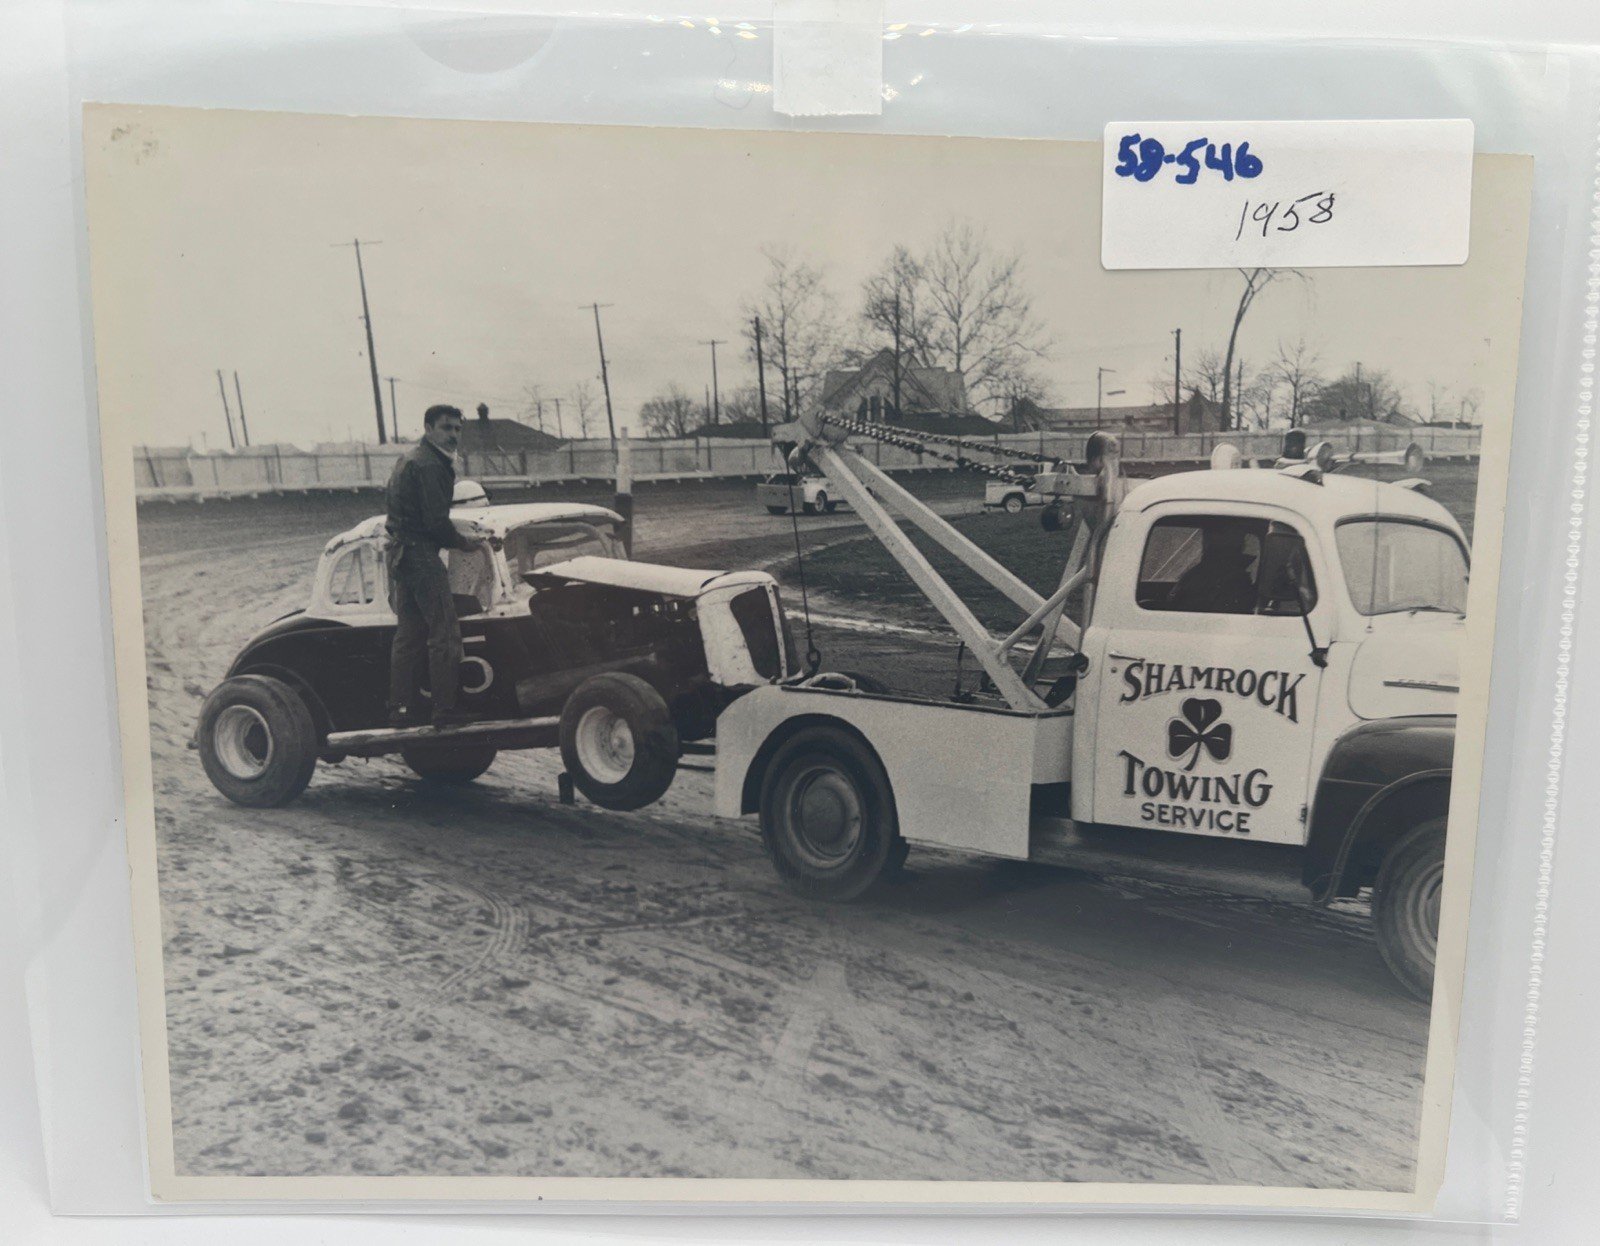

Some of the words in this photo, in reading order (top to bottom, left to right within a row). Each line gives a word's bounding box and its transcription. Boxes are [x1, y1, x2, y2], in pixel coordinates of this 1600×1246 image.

[1236, 192, 1336, 241] 1958
[1120, 661, 1306, 724] SHAMROCK
[1119, 750, 1273, 807] TOWING
[1141, 802, 1251, 833] SERVICE
